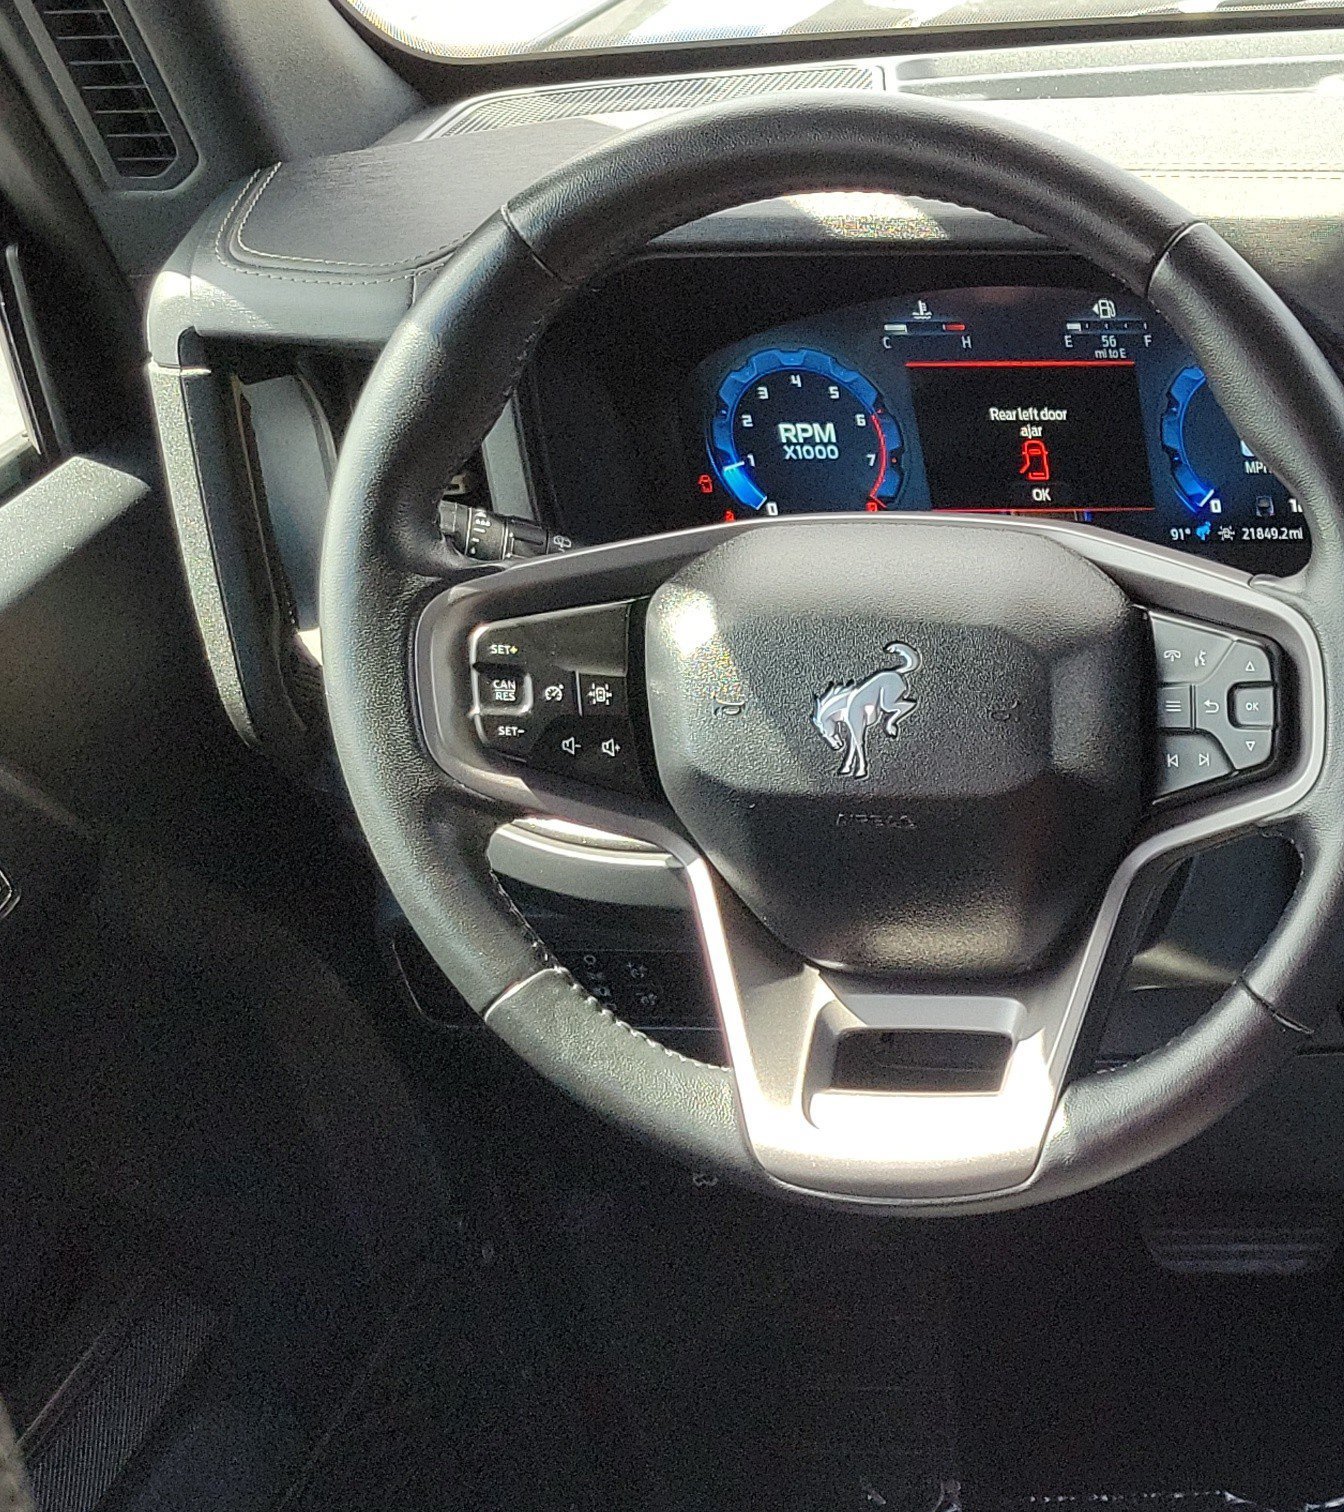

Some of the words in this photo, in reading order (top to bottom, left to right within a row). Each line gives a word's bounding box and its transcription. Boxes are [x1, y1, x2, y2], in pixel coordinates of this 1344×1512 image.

[883, 336, 892, 349] C
[962, 336, 972, 349] H
[1064, 335, 1074, 348] E
[1100, 335, 1117, 348] 56
[1143, 335, 1152, 348] F
[1108, 349, 1118, 359] to
[790, 374, 802, 388] 4
[757, 386, 769, 400] 3
[828, 386, 840, 400] 5
[855, 414, 867, 427] 6
[989, 407, 1017, 421] Rear
[1018, 407, 1040, 421] left
[1040, 407, 1068, 421] door
[741, 414, 754, 428] 2
[777, 422, 837, 444] RPM
[1019, 425, 1043, 439] ajar
[783, 445, 840, 460] X1000
[746, 454, 755, 467] 1
[866, 454, 877, 467] 7
[1032, 488, 1052, 501] OK
[766, 502, 779, 516] 0
[1210, 499, 1222, 514] 0
[492, 679, 516, 691] CAN
[495, 692, 516, 702] RES
[1245, 701, 1260, 711] OK
